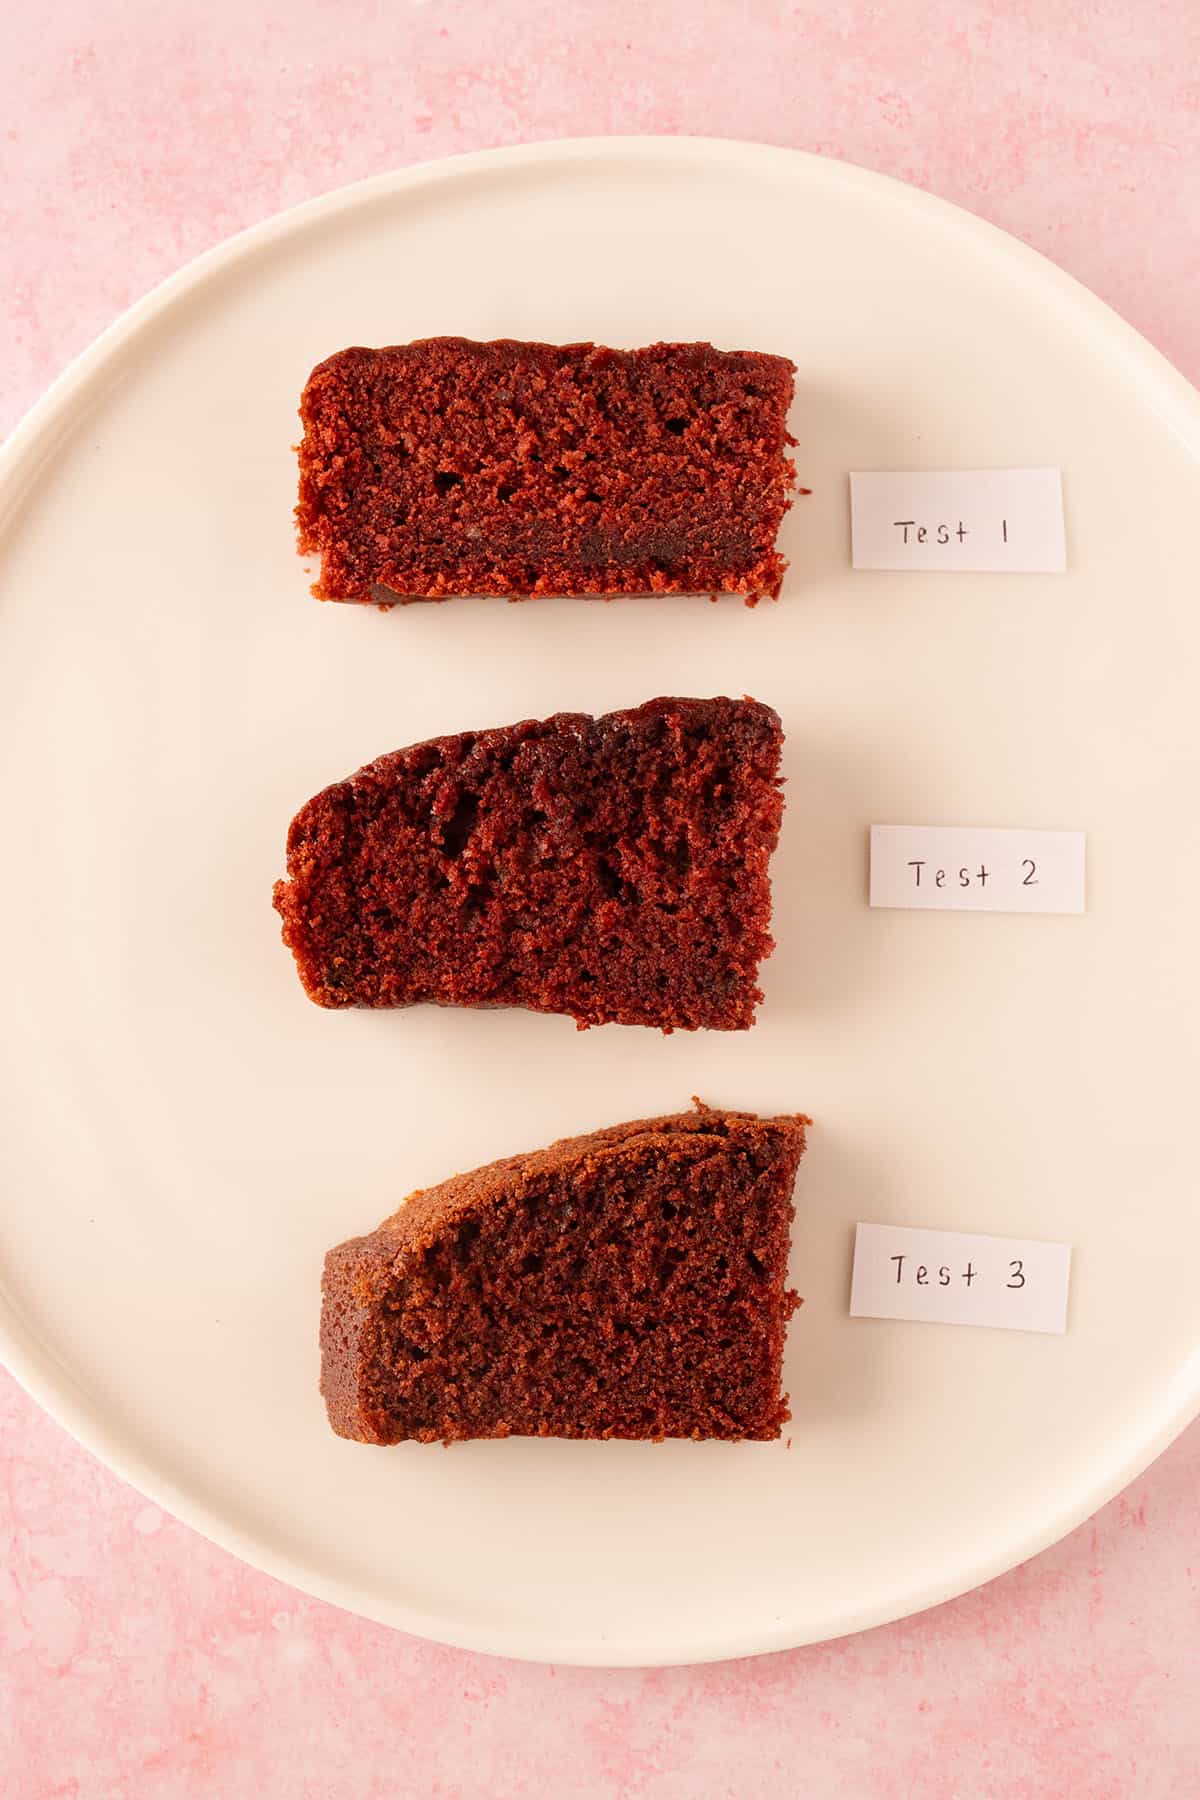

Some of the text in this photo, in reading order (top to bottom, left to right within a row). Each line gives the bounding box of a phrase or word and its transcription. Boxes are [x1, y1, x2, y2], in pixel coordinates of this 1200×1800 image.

[893, 520, 968, 544] Test
[907, 859, 1038, 888] Test 2
[890, 1255, 1026, 1289] Test 3
